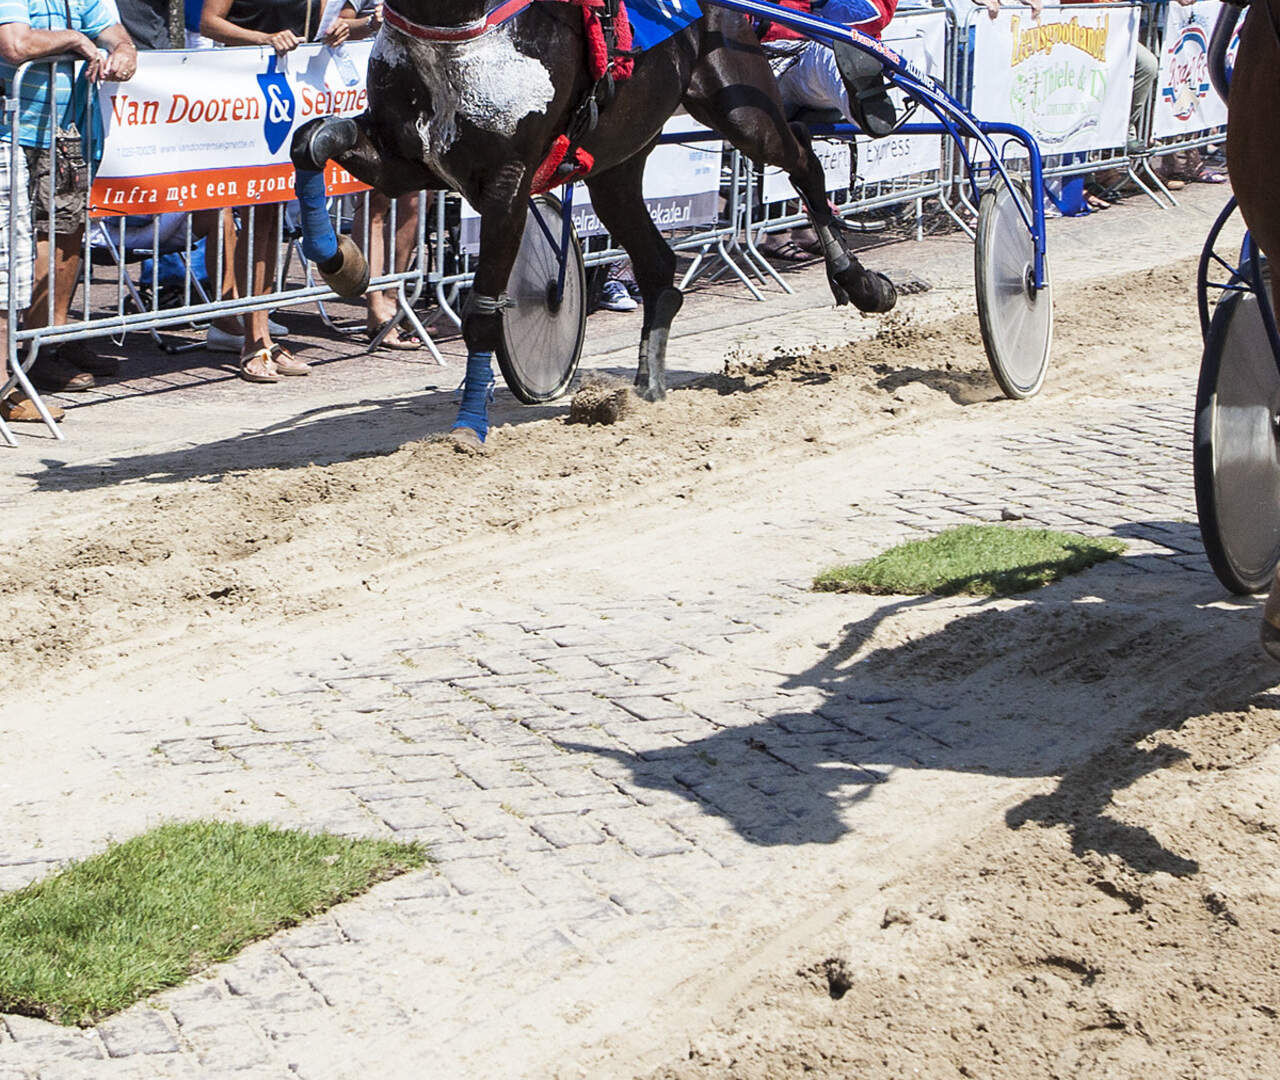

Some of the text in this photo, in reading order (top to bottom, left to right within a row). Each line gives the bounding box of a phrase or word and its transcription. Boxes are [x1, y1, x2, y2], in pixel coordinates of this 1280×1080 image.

[111, 82, 369, 127] Van Dooren & Seigne
[866, 138, 911, 166] Express
[103, 187, 157, 205] Infra
[166, 182, 197, 201] met
[206, 179, 238, 197] een
[247, 172, 297, 198] grond
